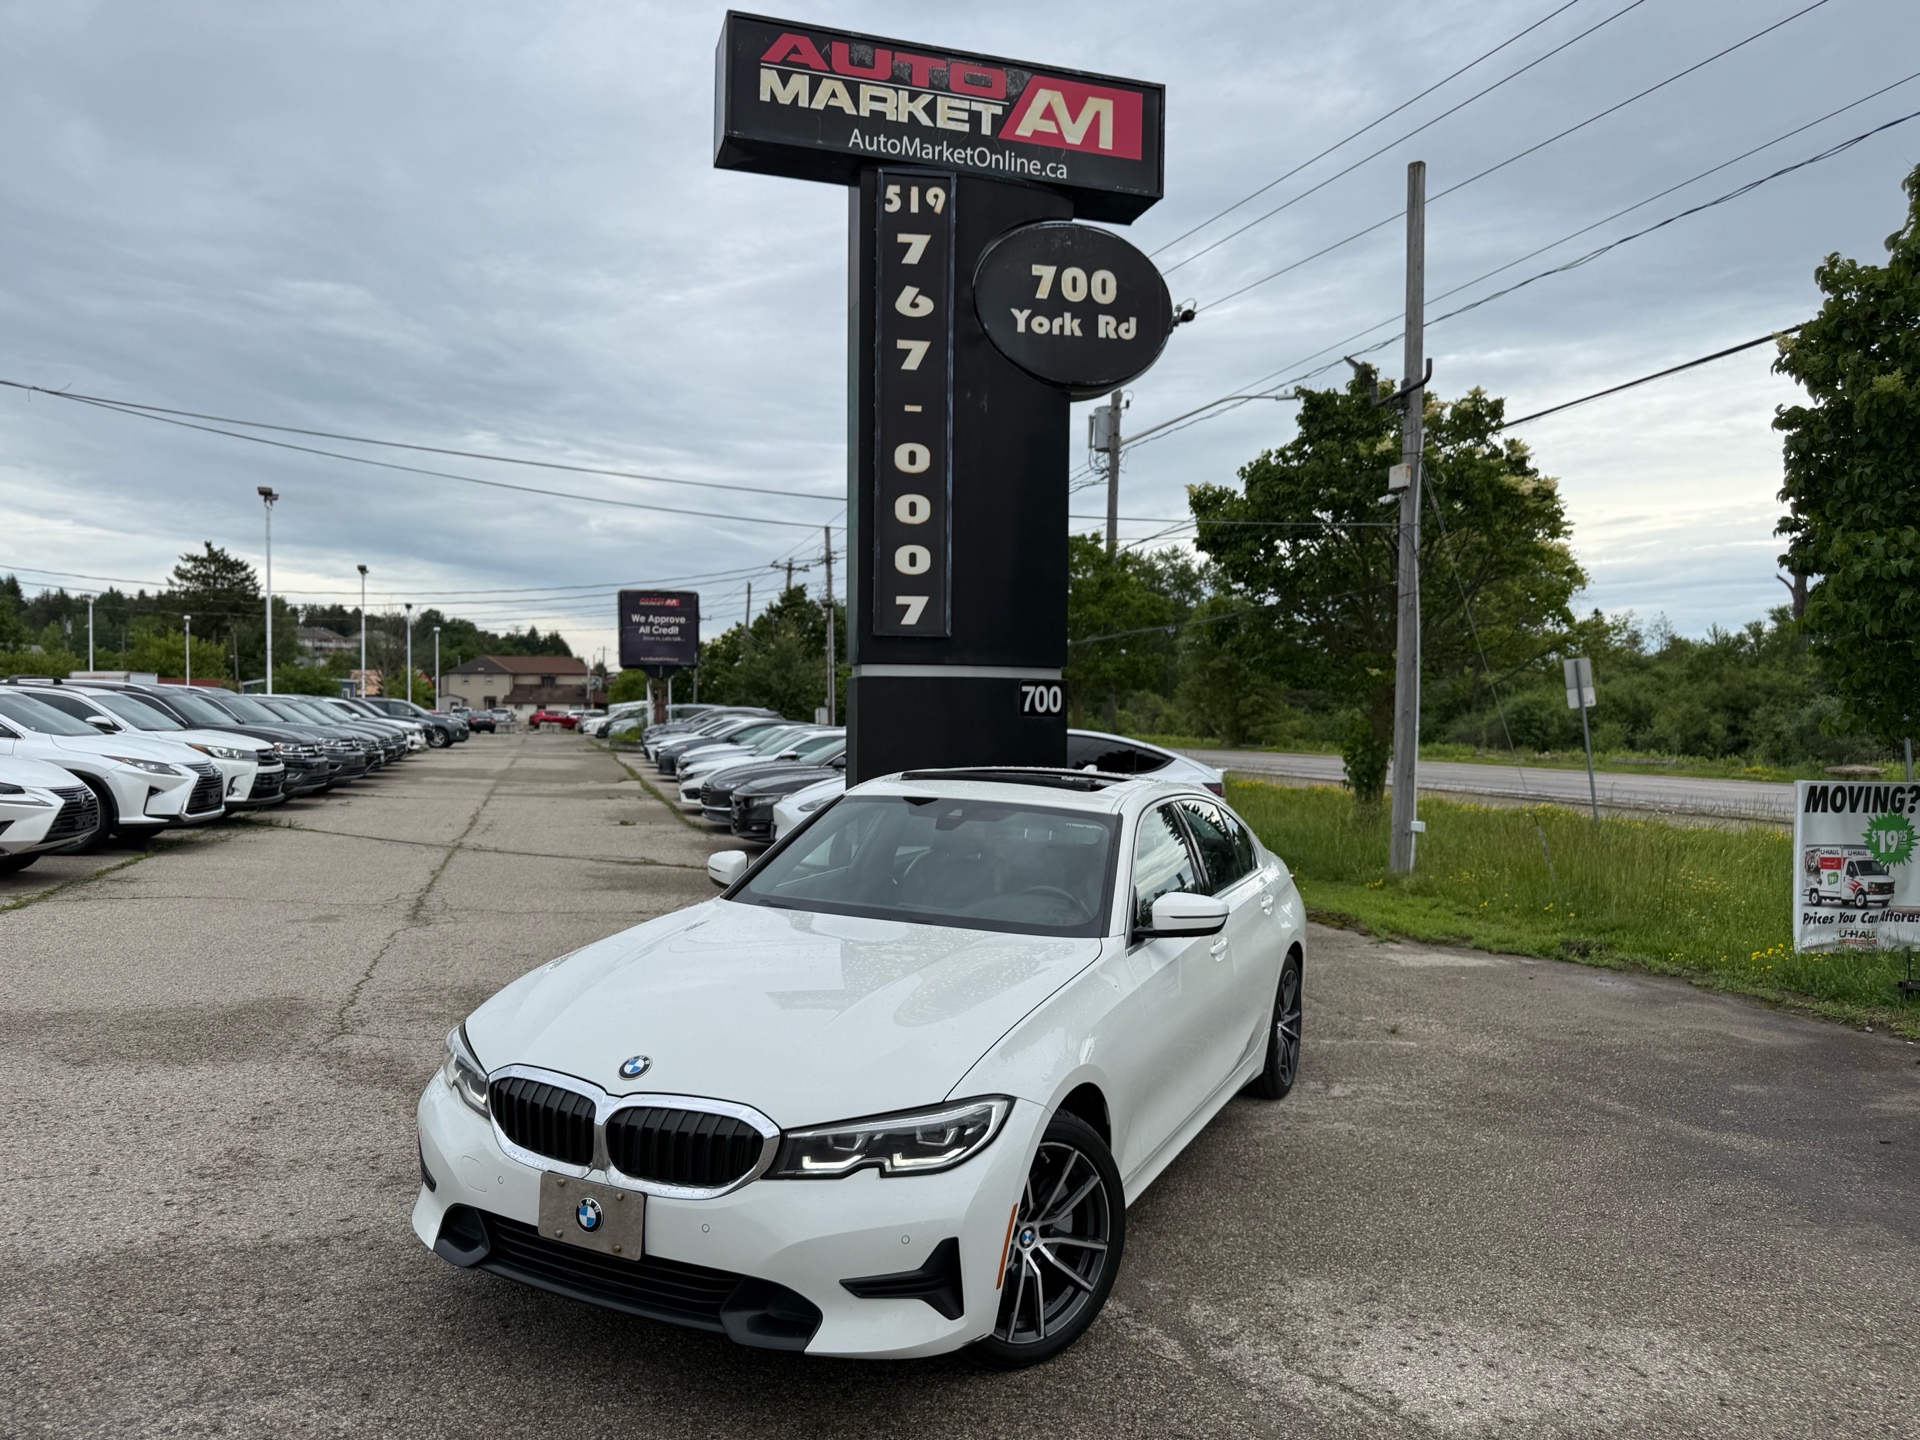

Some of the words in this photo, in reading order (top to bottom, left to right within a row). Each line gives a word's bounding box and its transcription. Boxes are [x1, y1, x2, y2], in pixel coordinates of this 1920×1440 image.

[760, 32, 1007, 99] AUTO
[759, 68, 1004, 136] MARKET
[848, 128, 1068, 180] AutoMarketOnline.ca
[884, 184, 947, 214] 519
[1031, 264, 1118, 305] 700
[1010, 308, 1083, 336] York
[1097, 314, 1137, 340] Rd
[631, 613, 646, 623] We
[648, 614, 686, 625] Approve
[638, 625, 650, 634] All
[652, 626, 679, 635] Credit
[1021, 685, 1063, 713] 700
[1804, 784, 1920, 814] MOVING?
[1802, 911, 1834, 925] Prices
[1838, 911, 1856, 924] You
[1860, 911, 1879, 924] Can
